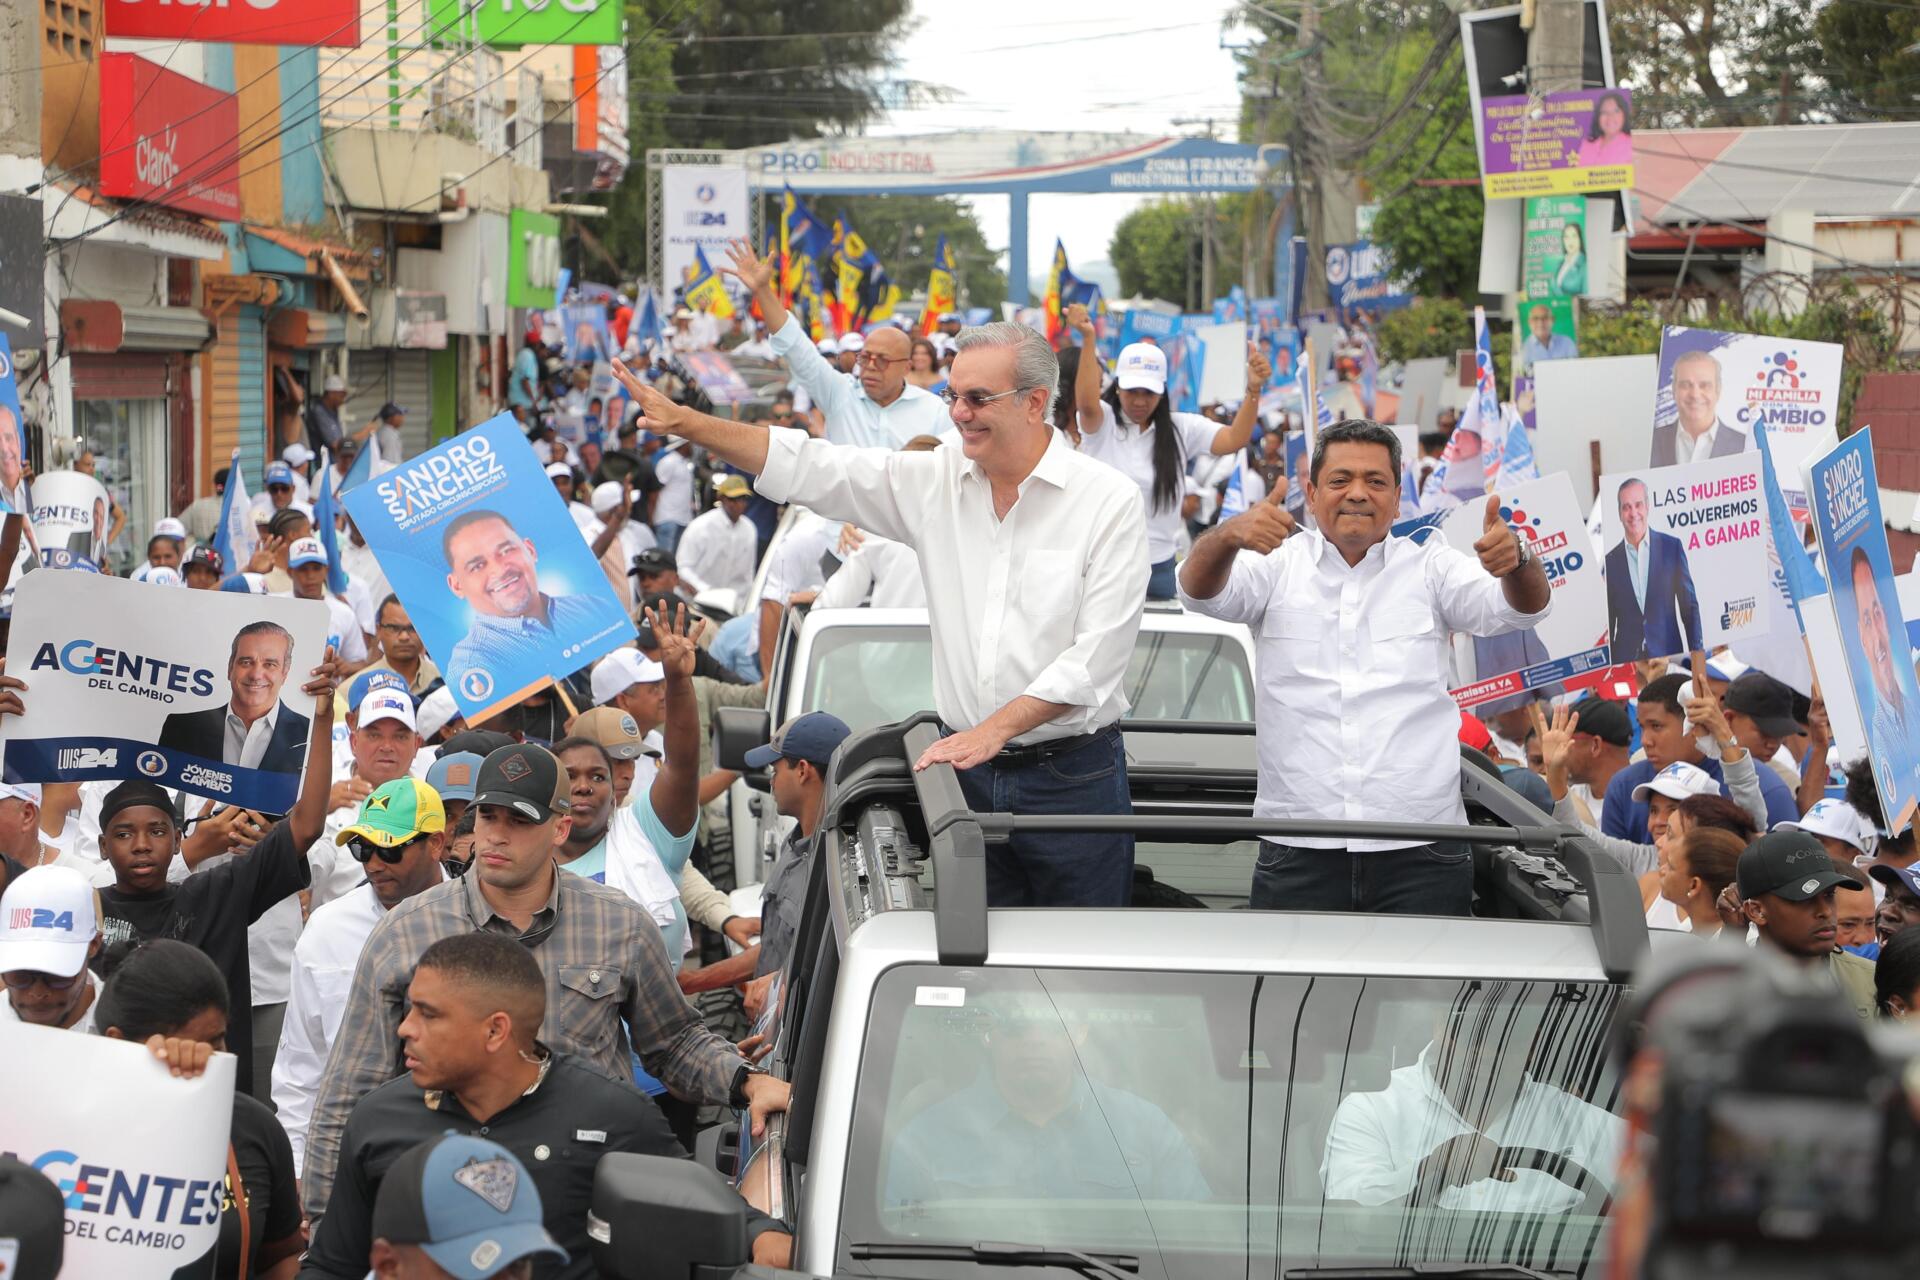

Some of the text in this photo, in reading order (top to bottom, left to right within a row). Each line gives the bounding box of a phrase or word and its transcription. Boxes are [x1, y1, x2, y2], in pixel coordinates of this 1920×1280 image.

[136, 126, 178, 188] Claro
[1748, 389, 1820, 402] MI FAMILIA
[377, 435, 490, 504] SANDRO
[1823, 448, 1862, 502] SANDRO
[1653, 487, 1687, 508] LAS
[1691, 474, 1757, 502] MUJERES
[32, 504, 89, 524] GENTES
[399, 506, 436, 531] DIPUTADO
[1667, 498, 1758, 529] VOLVEREMOS
[1688, 531, 1700, 551] A
[1704, 519, 1761, 547] GANAR
[1543, 551, 1583, 580] BIO
[1729, 601, 1756, 612] MUJERES
[30, 639, 215, 697] AGENTES
[88, 678, 174, 704] DEL CAMBIO
[1452, 683, 1497, 701] SCRÍBETE
[1498, 678, 1512, 688] YA
[180, 772, 233, 794] CAMBIO
[183, 763, 233, 784] JÓVENES
[31, 1149, 223, 1226] GENTES
[64, 1218, 186, 1250] DEL CAMBIO
